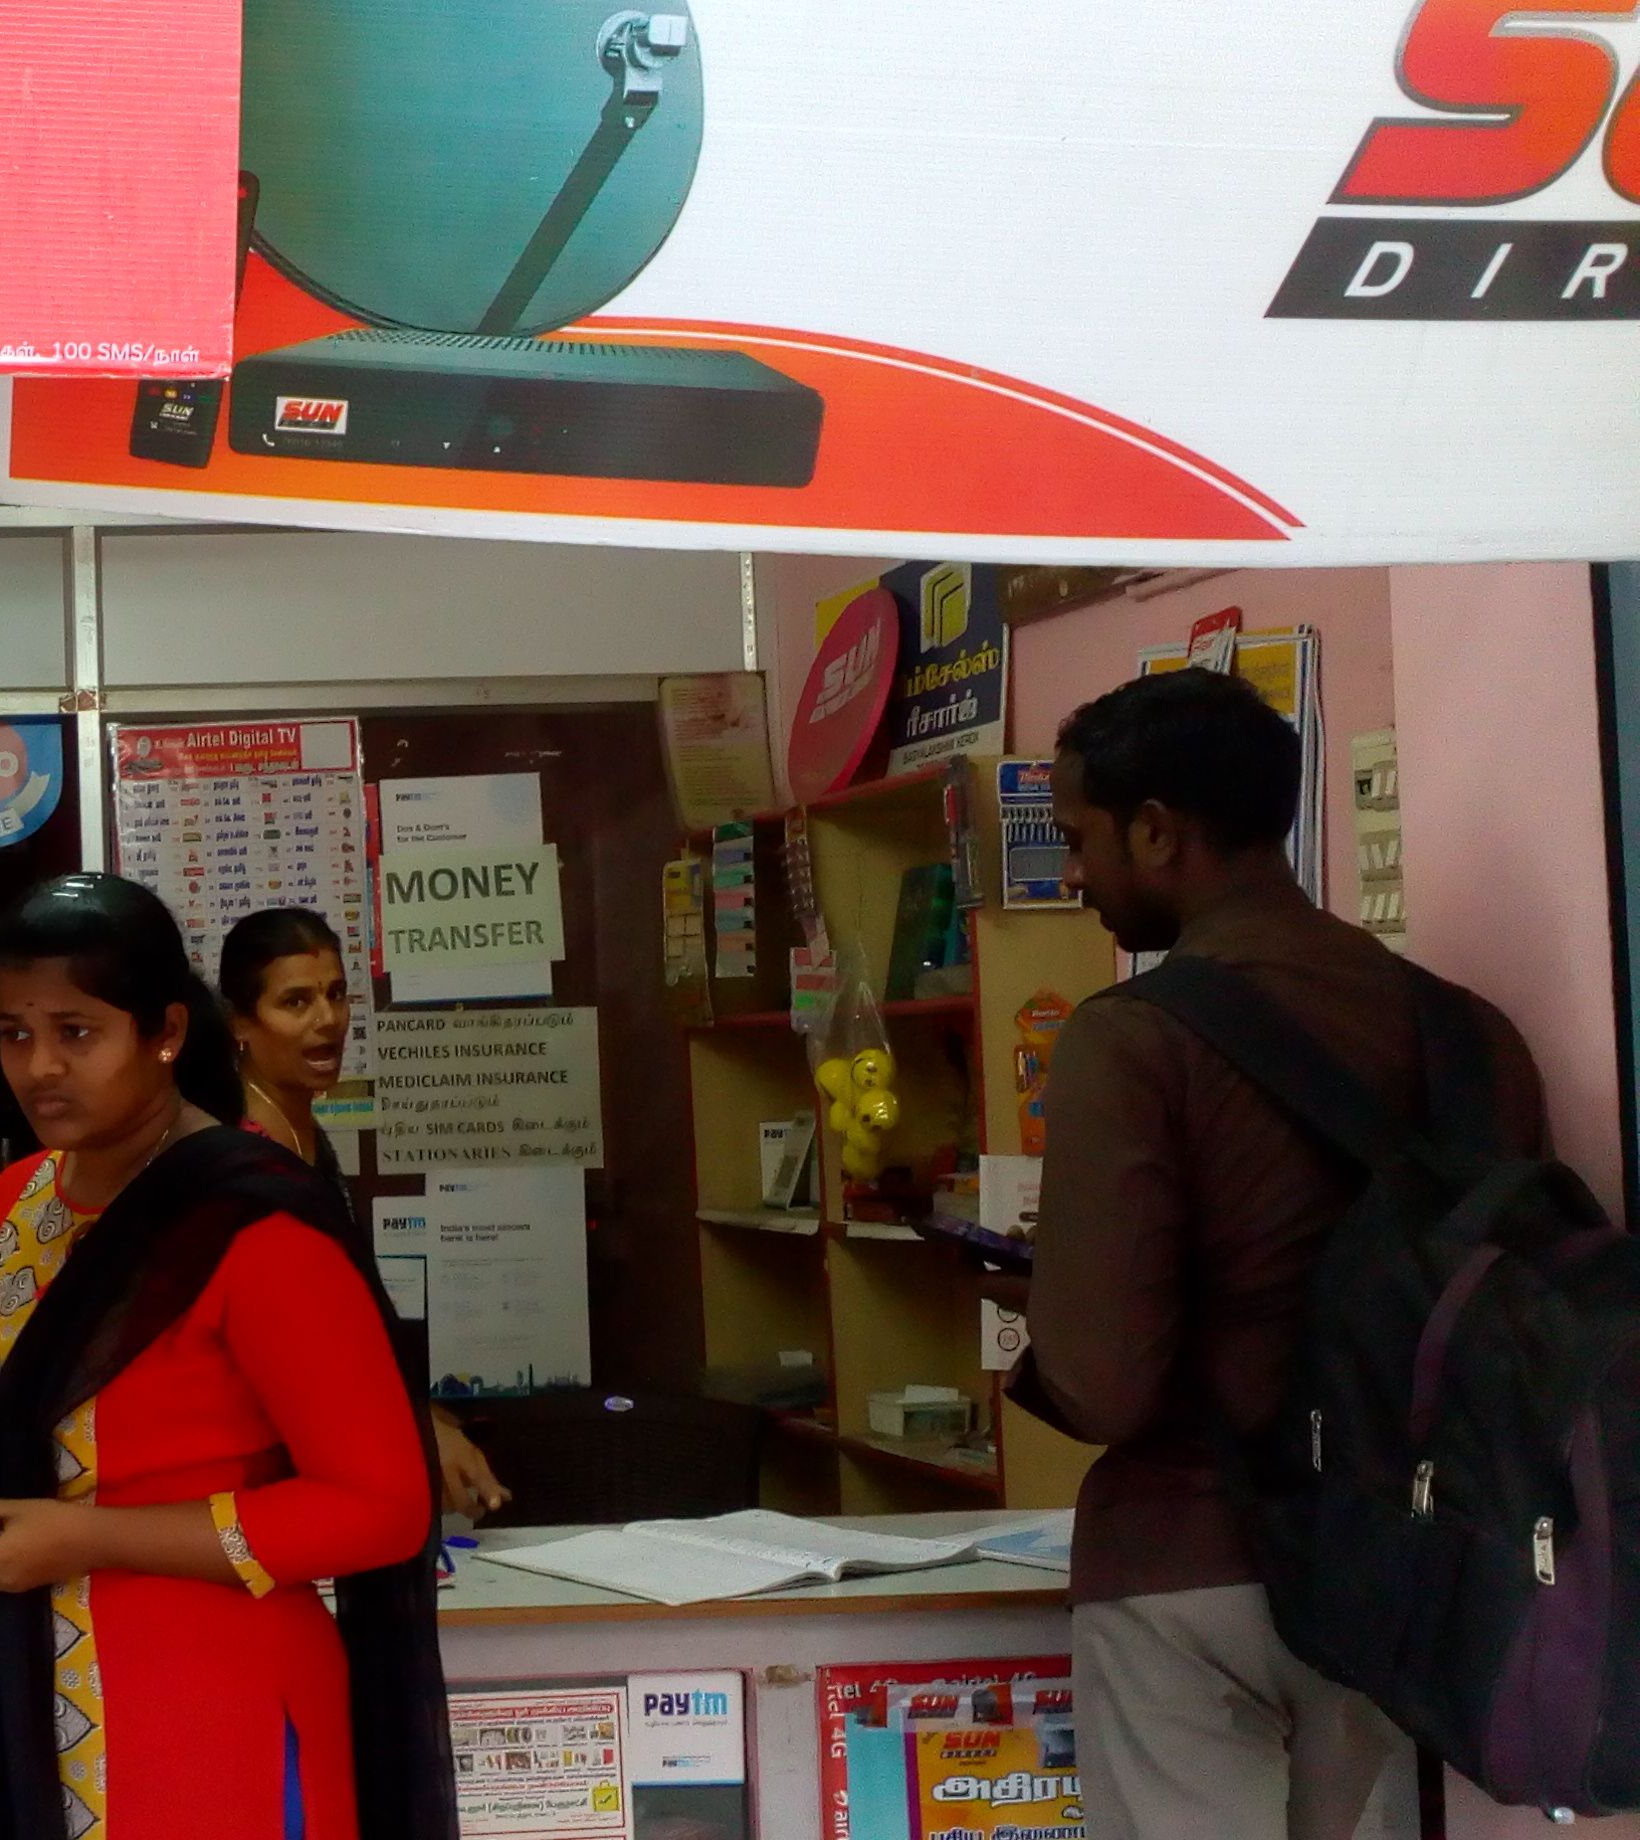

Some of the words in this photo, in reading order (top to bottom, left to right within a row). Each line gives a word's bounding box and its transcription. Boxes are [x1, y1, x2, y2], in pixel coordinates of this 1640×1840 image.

[1326, 0, 1640, 207] S
[1344, 241, 1628, 299] DIR
[53, 341, 91, 360] 100
[282, 401, 342, 421] SUN
[229, 730, 273, 748] Digital
[277, 728, 296, 743] TV
[386, 862, 539, 904] MONEY
[388, 920, 544, 954] TRANSFER
[377, 1018, 446, 1032] PANCARD
[378, 1045, 450, 1061] VECHILES
[455, 1042, 547, 1058] INSURANCE
[378, 1073, 472, 1089] MEDICLAIM
[477, 1070, 569, 1086] INSURANCE
[426, 1121, 456, 1136] SIM
[458, 1120, 505, 1135] CARDS
[383, 1216, 426, 1231] paytm
[644, 1688, 728, 1717] paytm
